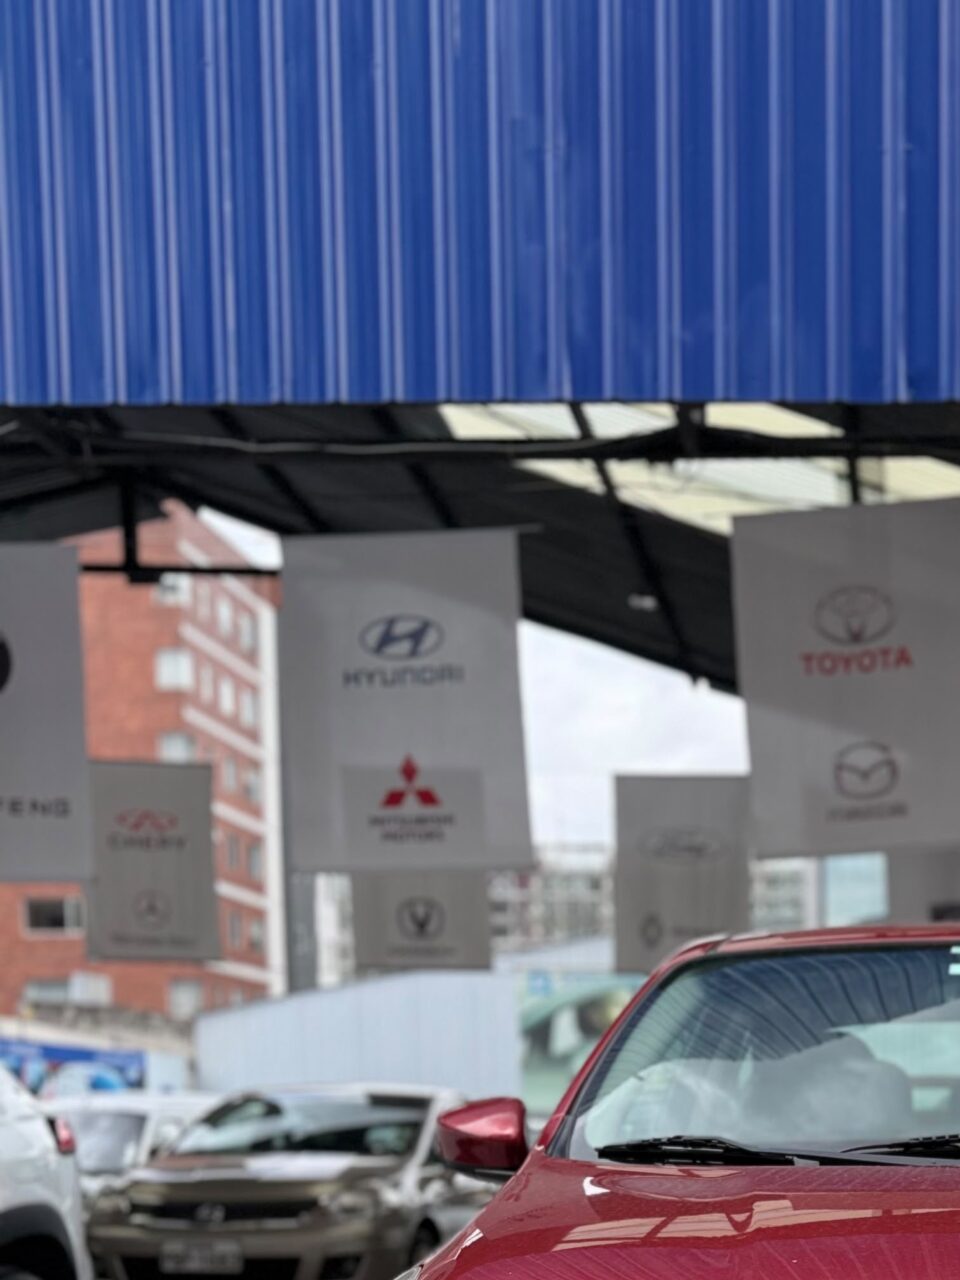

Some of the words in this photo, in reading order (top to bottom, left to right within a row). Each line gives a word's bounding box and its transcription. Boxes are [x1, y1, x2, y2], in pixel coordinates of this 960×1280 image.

[800, 645, 914, 676] TOYOTA
[342, 664, 464, 687] HYUNDAI
[0, 797, 71, 818] ENG
